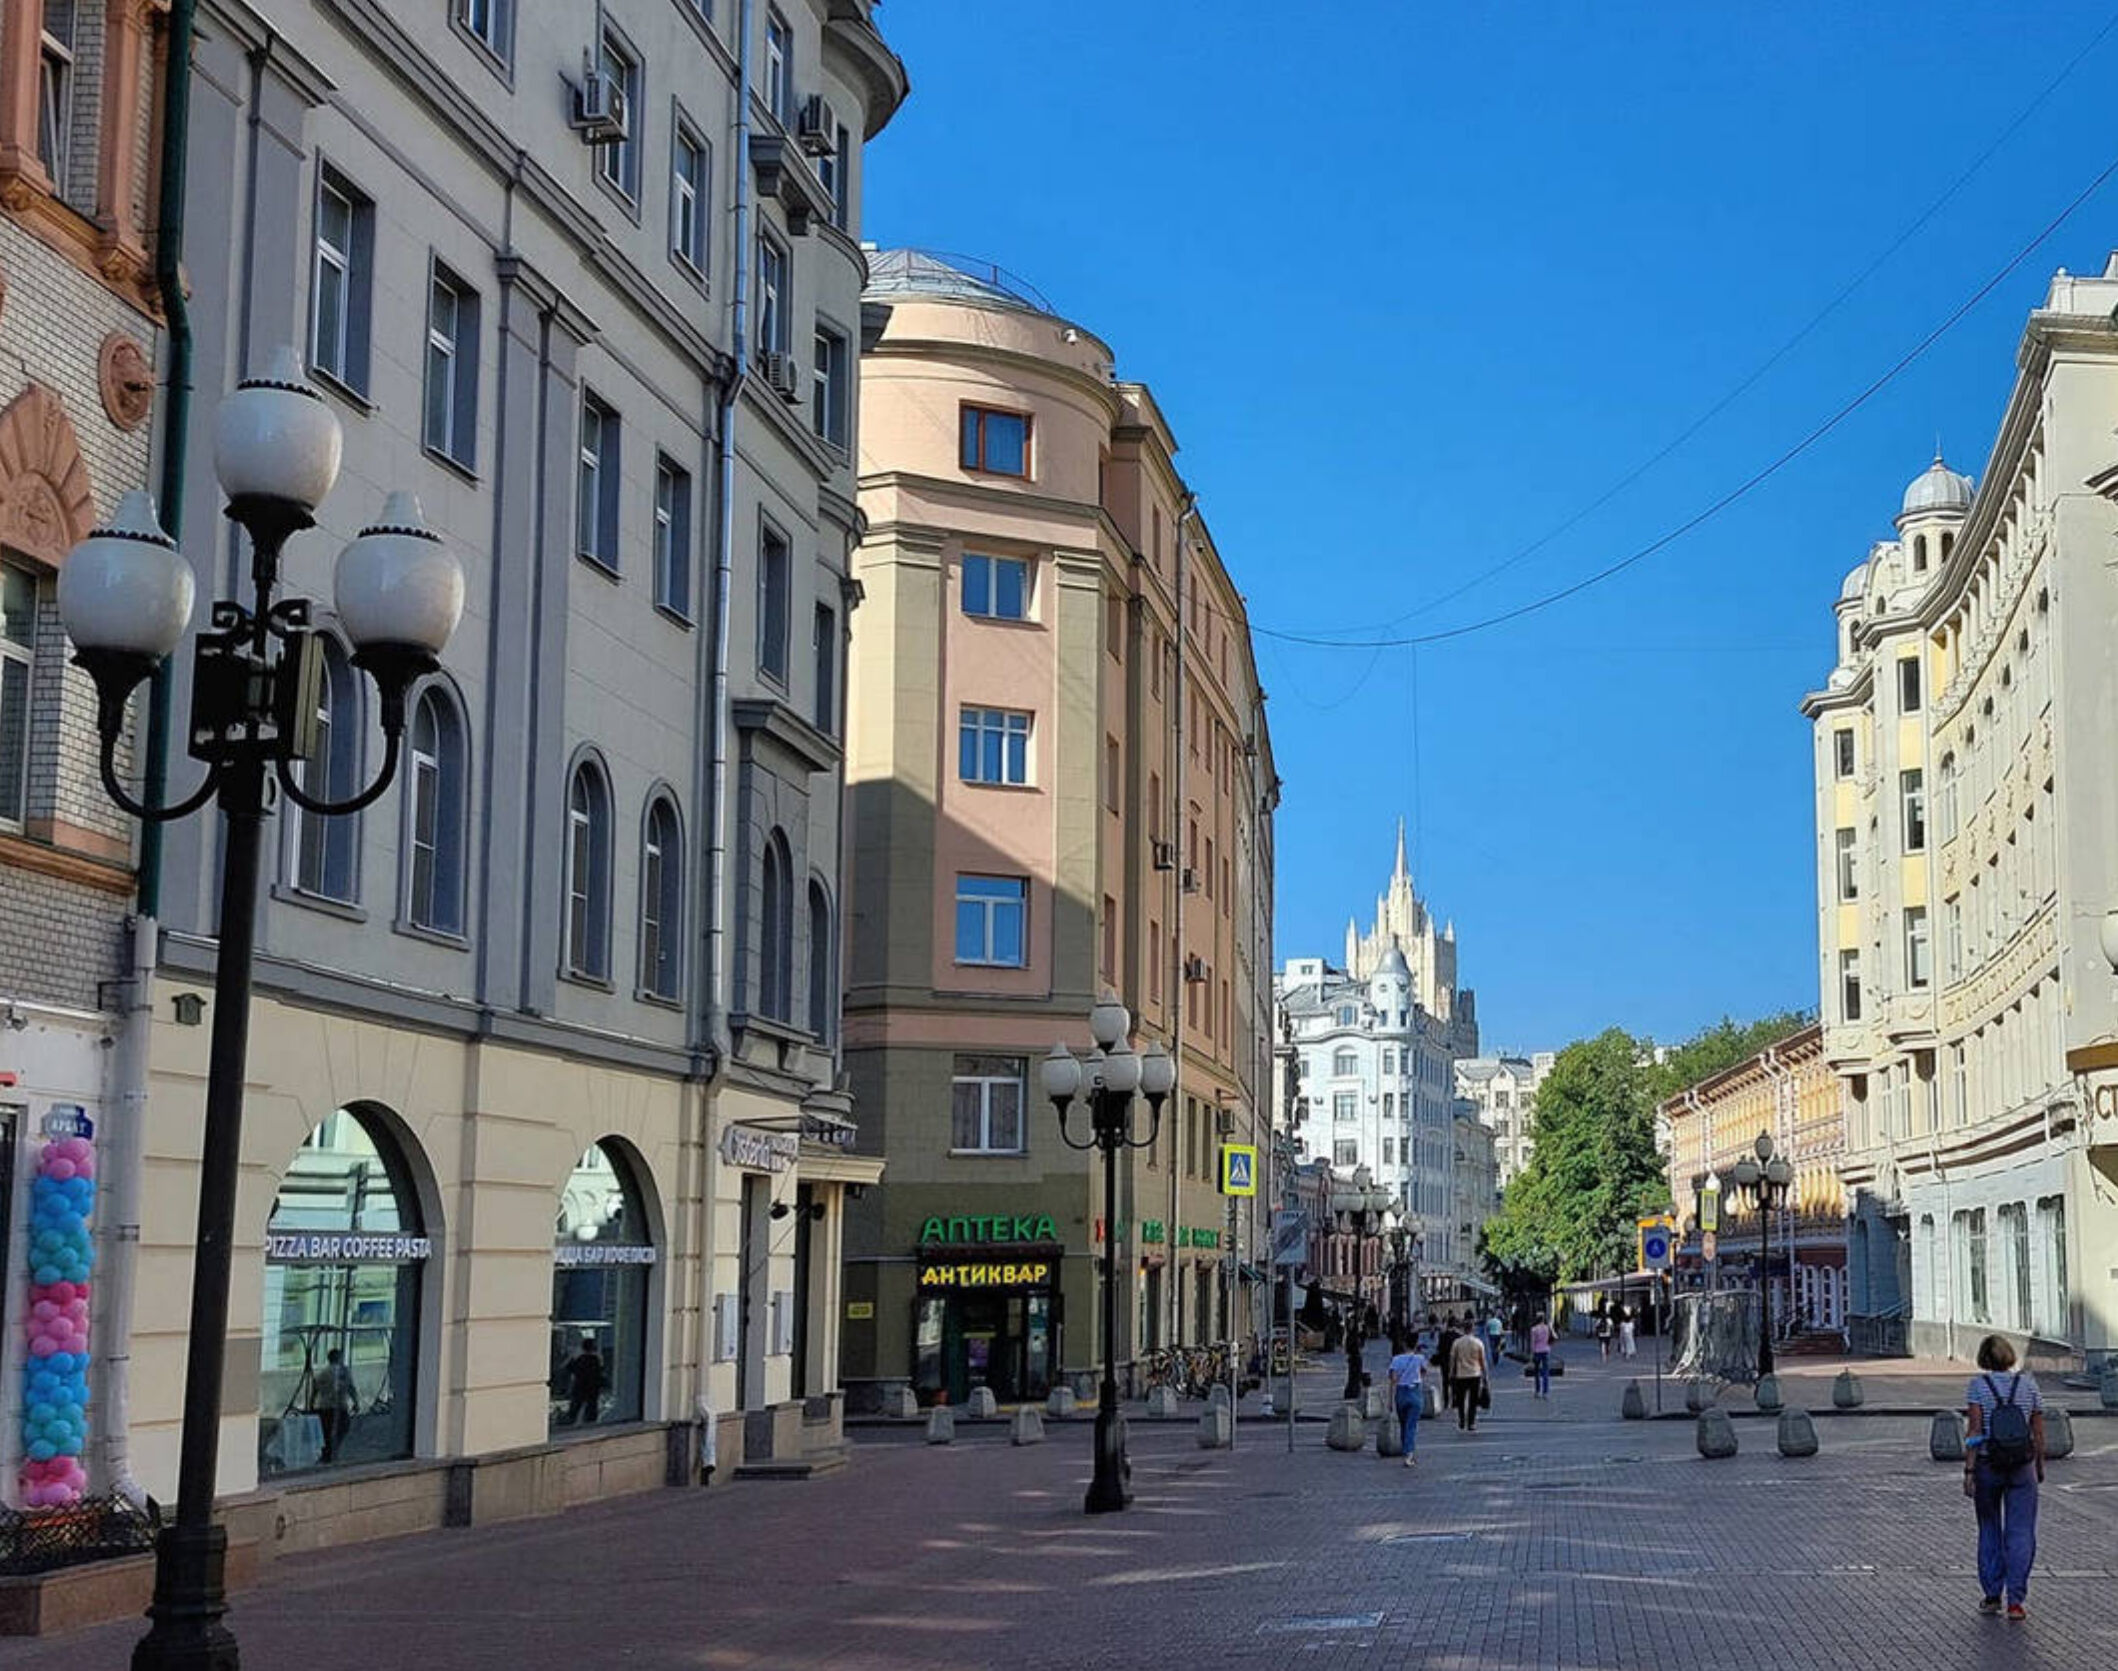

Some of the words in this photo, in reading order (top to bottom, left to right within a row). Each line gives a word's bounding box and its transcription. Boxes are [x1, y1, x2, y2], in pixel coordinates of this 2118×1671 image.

[921, 1213, 1057, 1243] АПТЕКА
[310, 1236, 340, 1258] BAR
[343, 1237, 394, 1259] COFFEE
[396, 1237, 432, 1259] PASTA
[921, 1264, 1047, 1287] АНТИКВАР
